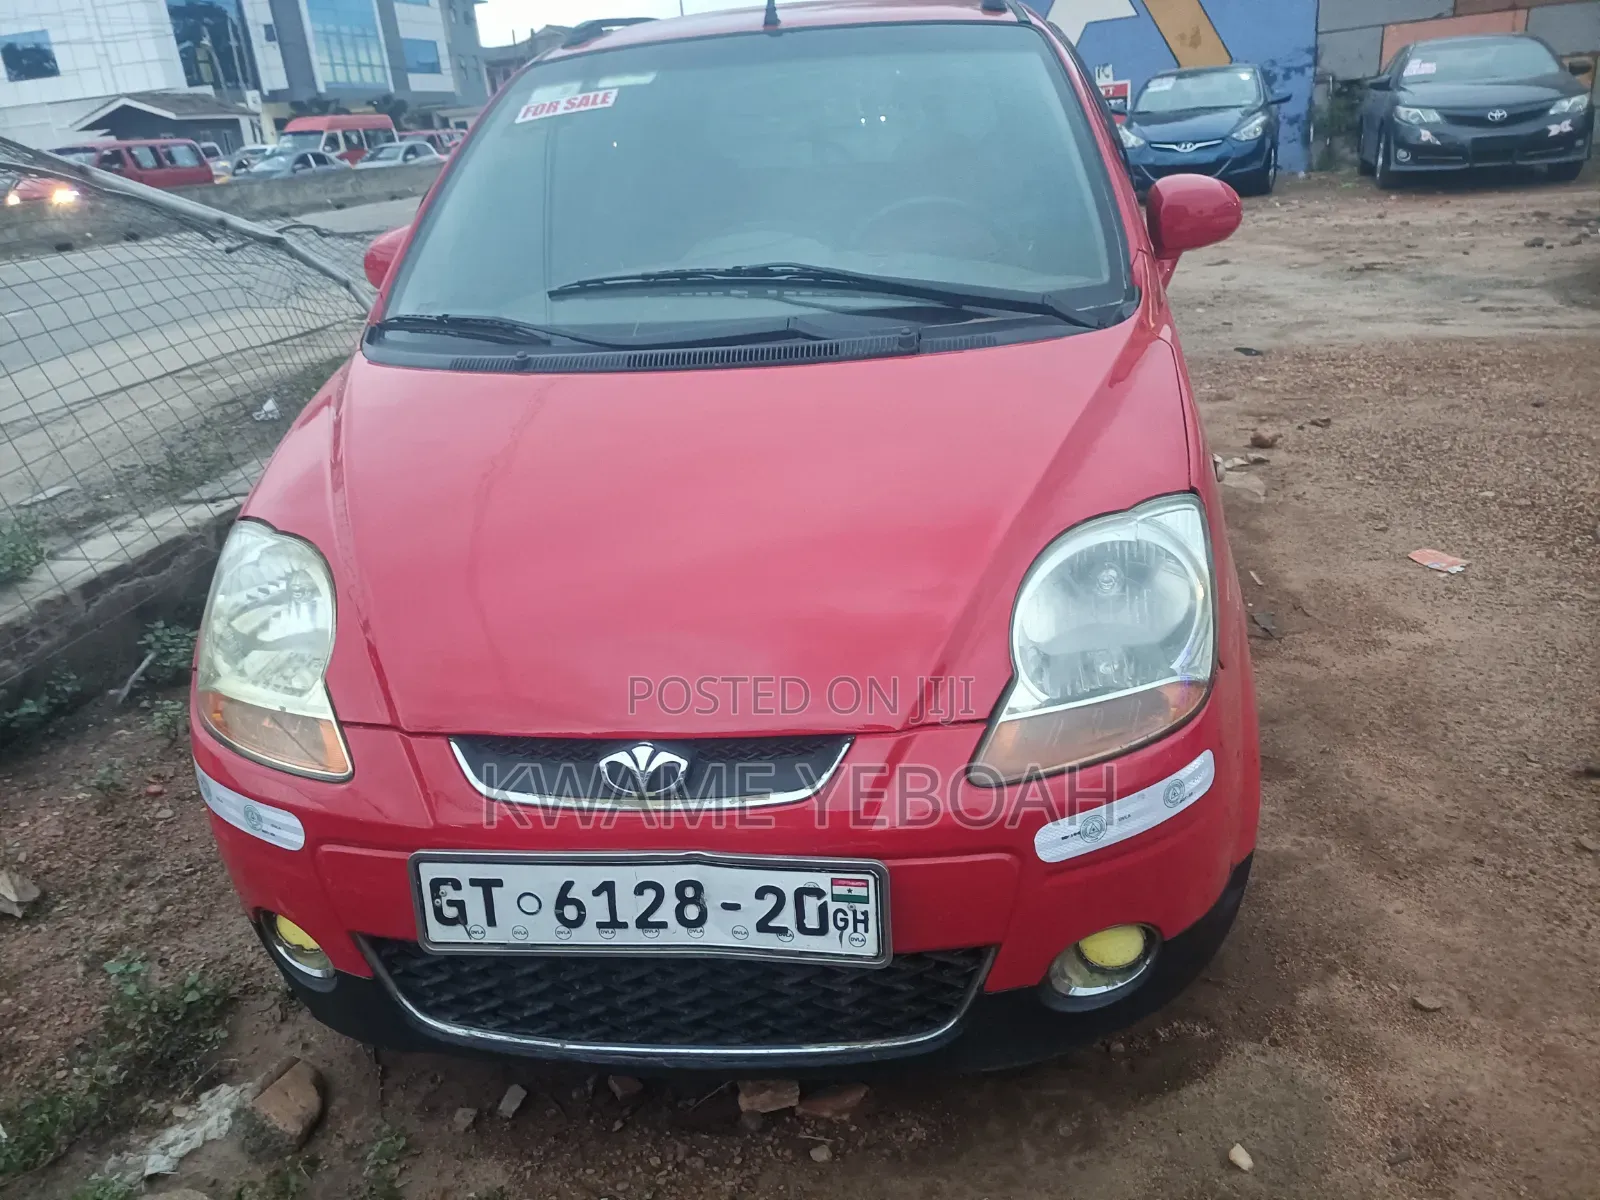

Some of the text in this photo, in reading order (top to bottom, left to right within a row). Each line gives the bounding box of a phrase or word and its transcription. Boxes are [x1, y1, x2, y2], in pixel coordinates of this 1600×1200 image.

[522, 92, 612, 119] FOR SALE
[429, 877, 504, 927] GT
[832, 908, 869, 934] GH
